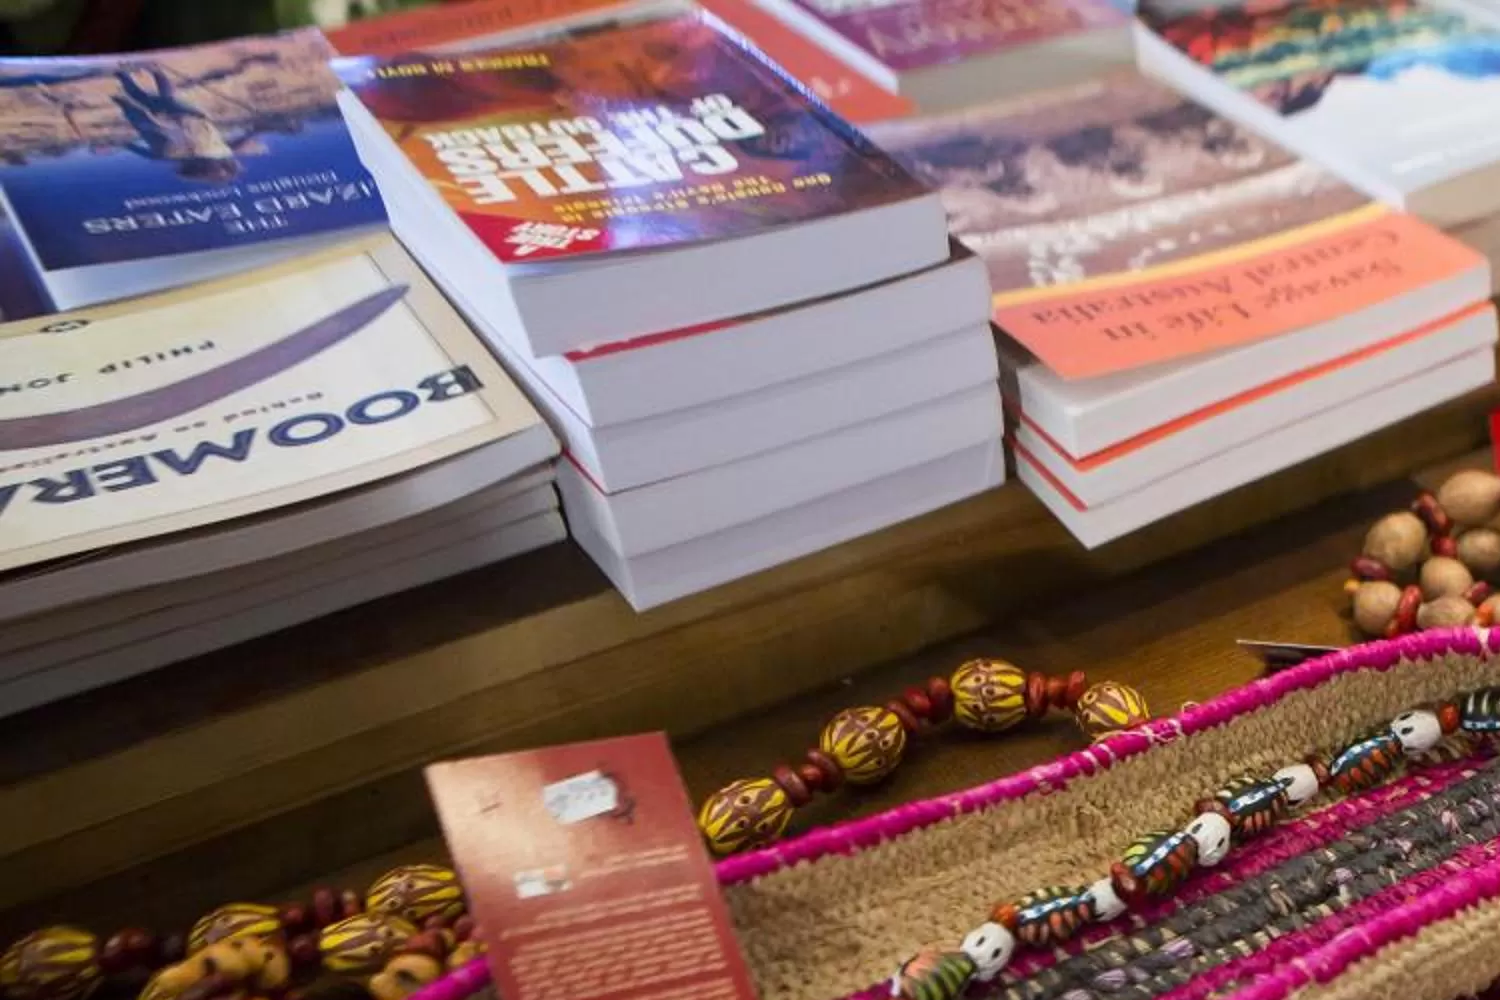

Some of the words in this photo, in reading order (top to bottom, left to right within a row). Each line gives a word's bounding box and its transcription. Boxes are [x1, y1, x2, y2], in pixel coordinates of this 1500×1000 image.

[425, 116, 602, 150] OUTBACK
[438, 107, 765, 175] DUFFERS
[456, 144, 739, 205] CATTLE
[254, 177, 374, 214] IZARD
[82, 202, 242, 235] EATERS
[1244, 229, 1399, 287] Central
[1032, 274, 1235, 324] Australia
[1256, 257, 1403, 309] Savage
[1101, 320, 1157, 341] in
[1158, 300, 1252, 334] Life
[97, 339, 216, 374] PHILIP
